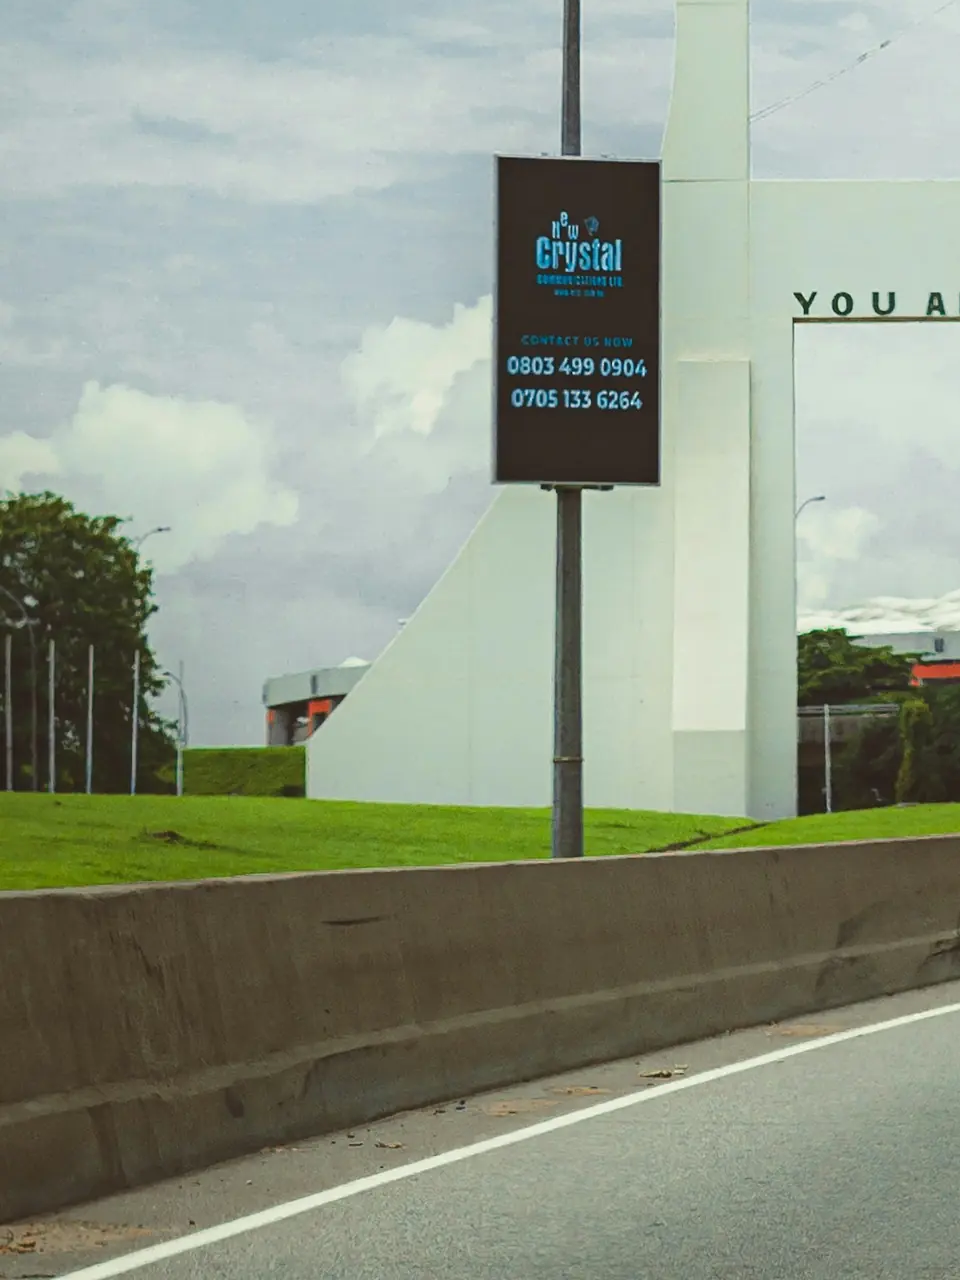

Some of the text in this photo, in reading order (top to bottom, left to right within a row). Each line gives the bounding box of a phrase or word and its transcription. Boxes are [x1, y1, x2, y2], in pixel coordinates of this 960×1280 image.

[536, 236, 623, 272] Crystal
[793, 291, 896, 316] YOU
[520, 335, 633, 348] CONTACT US NOW
[506, 355, 648, 378] 0803 499 0904
[511, 388, 643, 410] 0705 133 6264
